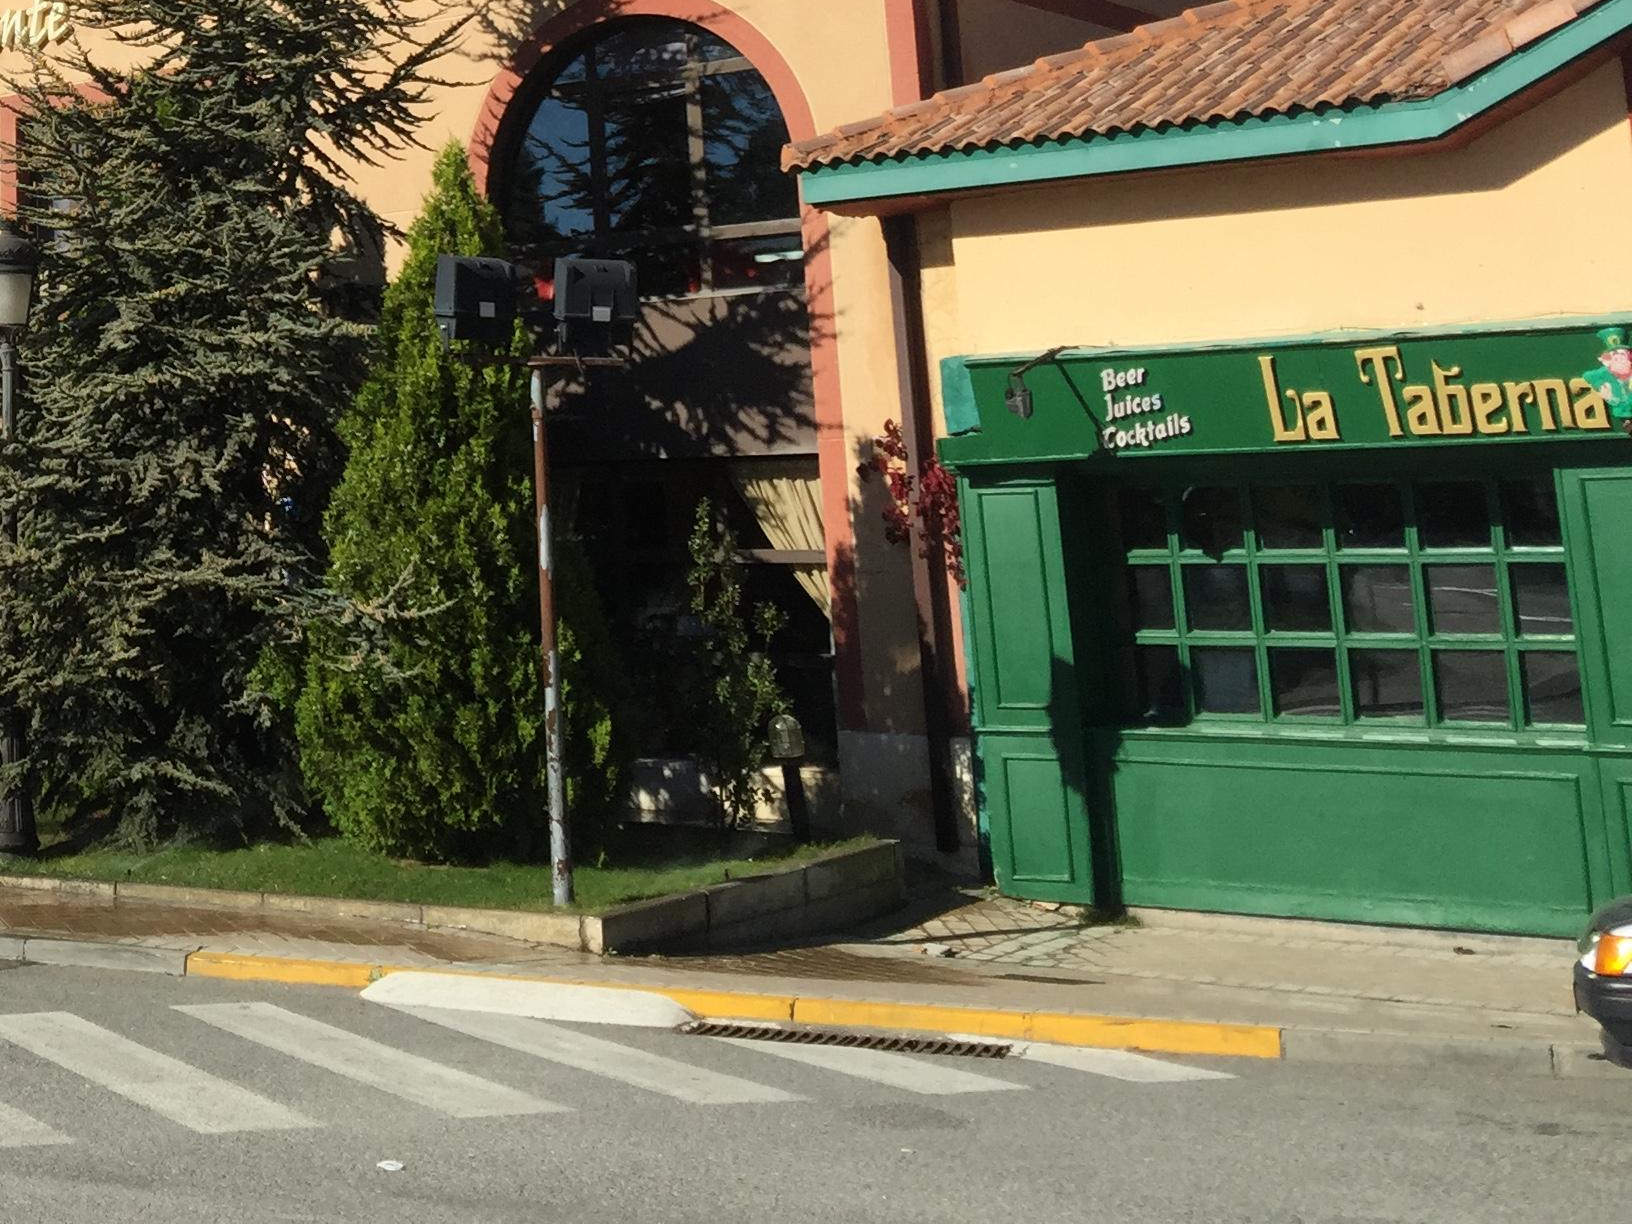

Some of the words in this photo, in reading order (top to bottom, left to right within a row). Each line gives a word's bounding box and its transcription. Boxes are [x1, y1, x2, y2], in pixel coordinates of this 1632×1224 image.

[1100, 367, 1145, 392] Beer
[1257, 355, 1341, 442] La
[1354, 345, 1611, 436] Taberna
[1104, 393, 1162, 422] Juices
[1102, 412, 1191, 449] Cocktails
